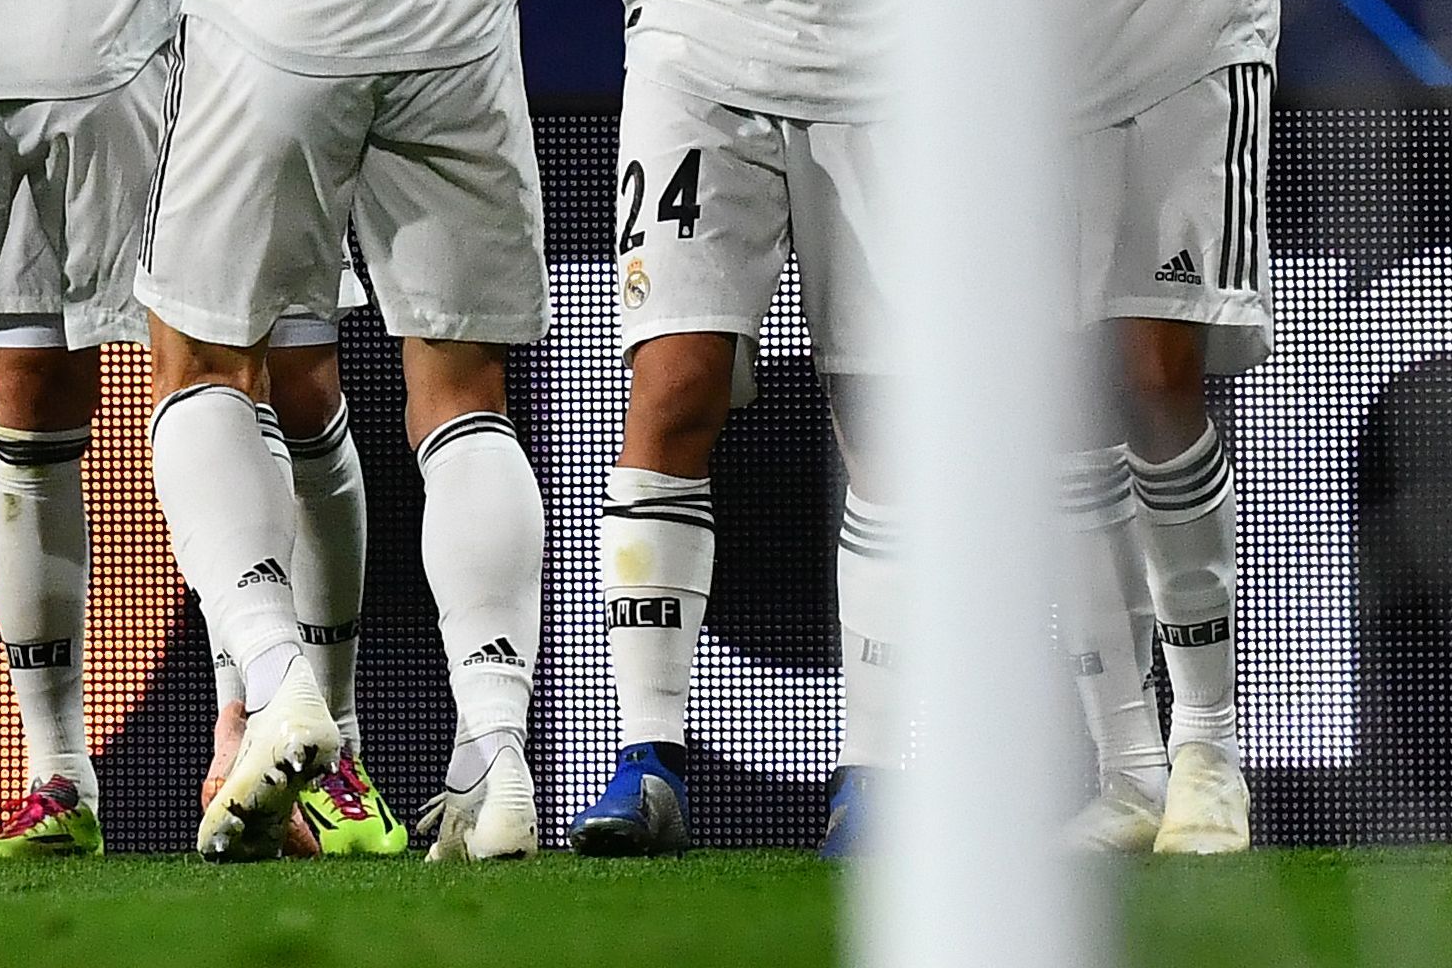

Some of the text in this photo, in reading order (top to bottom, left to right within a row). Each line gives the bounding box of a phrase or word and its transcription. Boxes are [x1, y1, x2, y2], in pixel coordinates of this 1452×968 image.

[619, 148, 701, 255] 24
[1154, 270, 1202, 285] adidas
[8, 642, 67, 667] MCF
[463, 654, 525, 668] adidas
